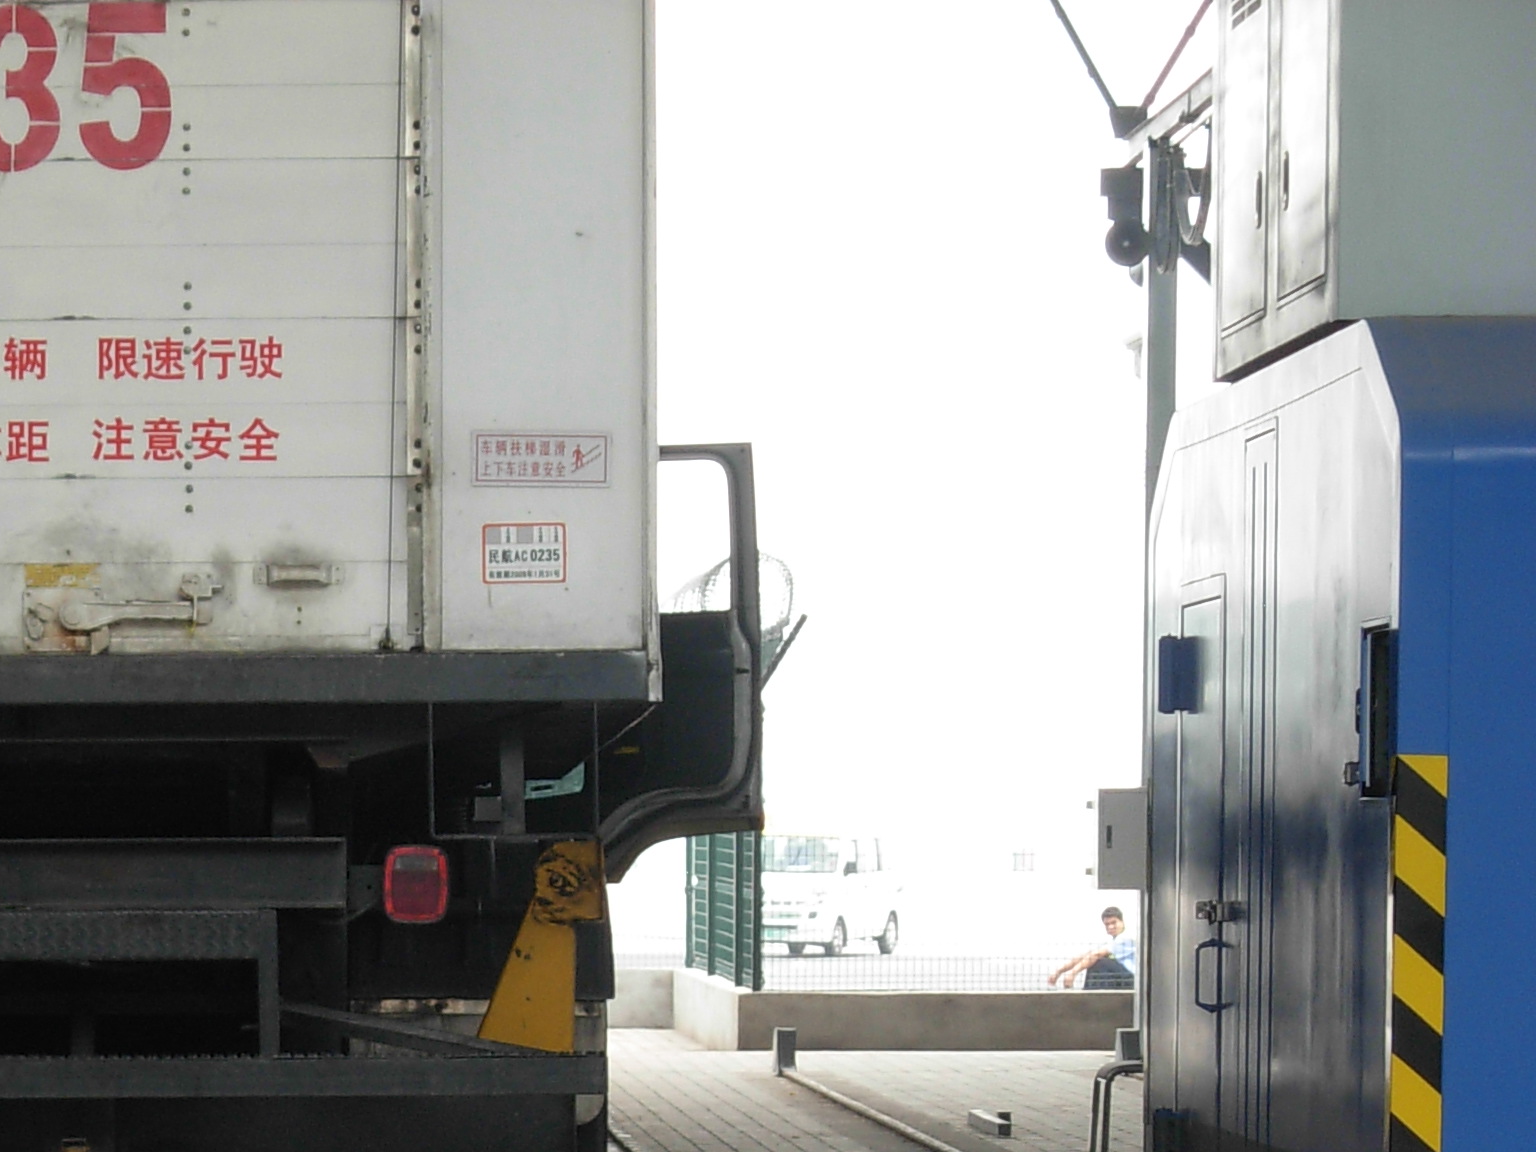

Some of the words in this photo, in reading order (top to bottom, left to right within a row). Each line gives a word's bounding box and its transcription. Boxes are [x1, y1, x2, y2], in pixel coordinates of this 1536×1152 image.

[97, 337, 283, 380] 限速行驶
[92, 418, 279, 462] 注意安全
[481, 461, 566, 477] 上下车注意安全
